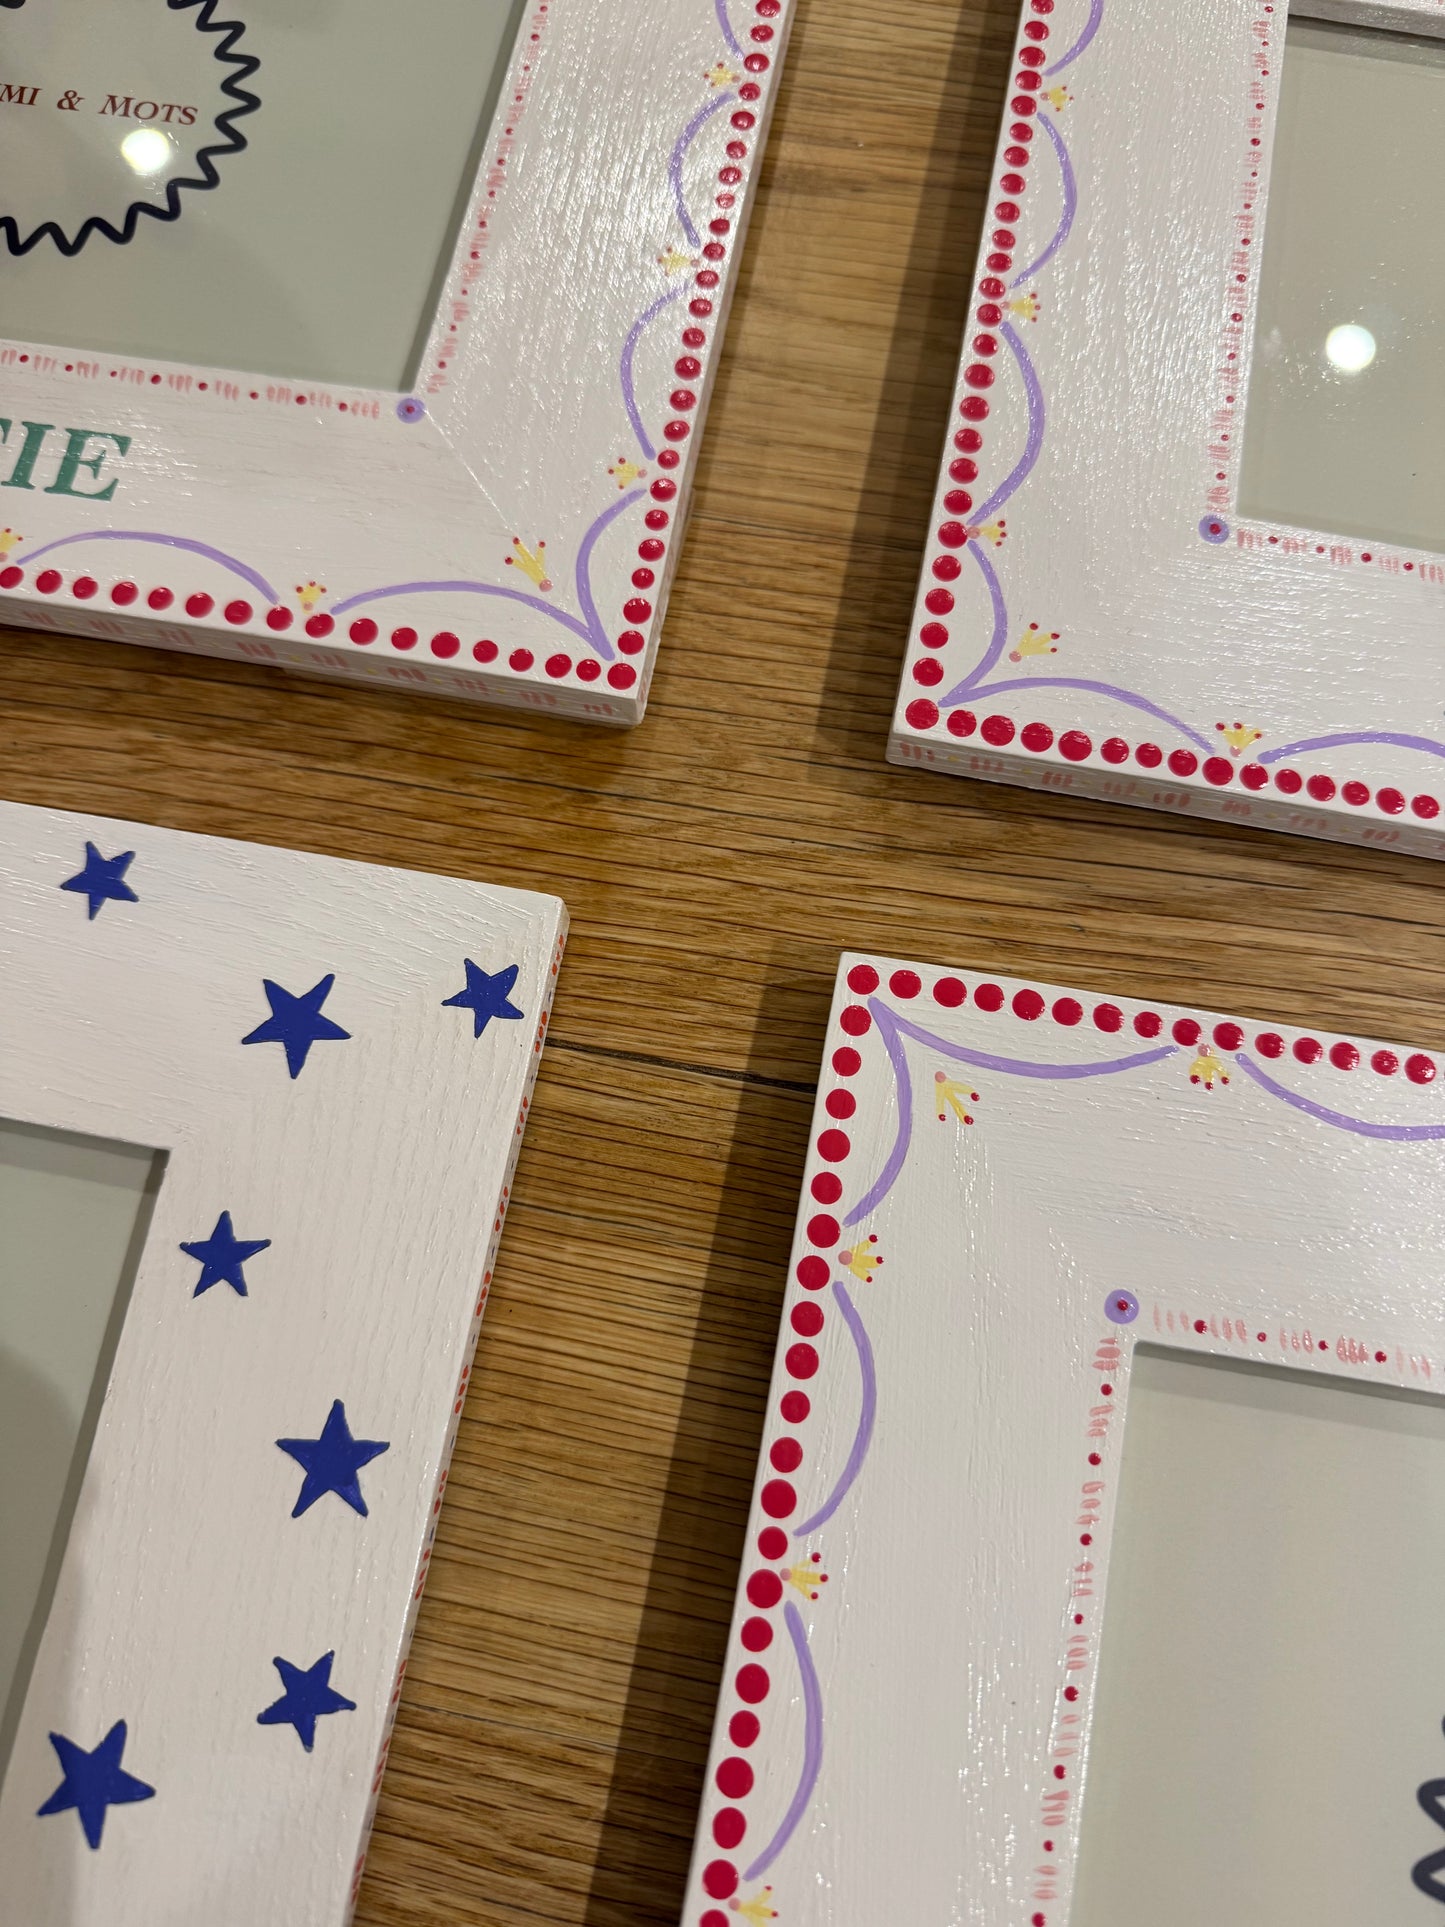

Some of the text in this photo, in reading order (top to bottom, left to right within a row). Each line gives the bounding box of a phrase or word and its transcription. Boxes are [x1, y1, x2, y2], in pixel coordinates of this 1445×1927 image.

[0, 83, 199, 126] MI & MOTS
[0, 417, 132, 501] IE
